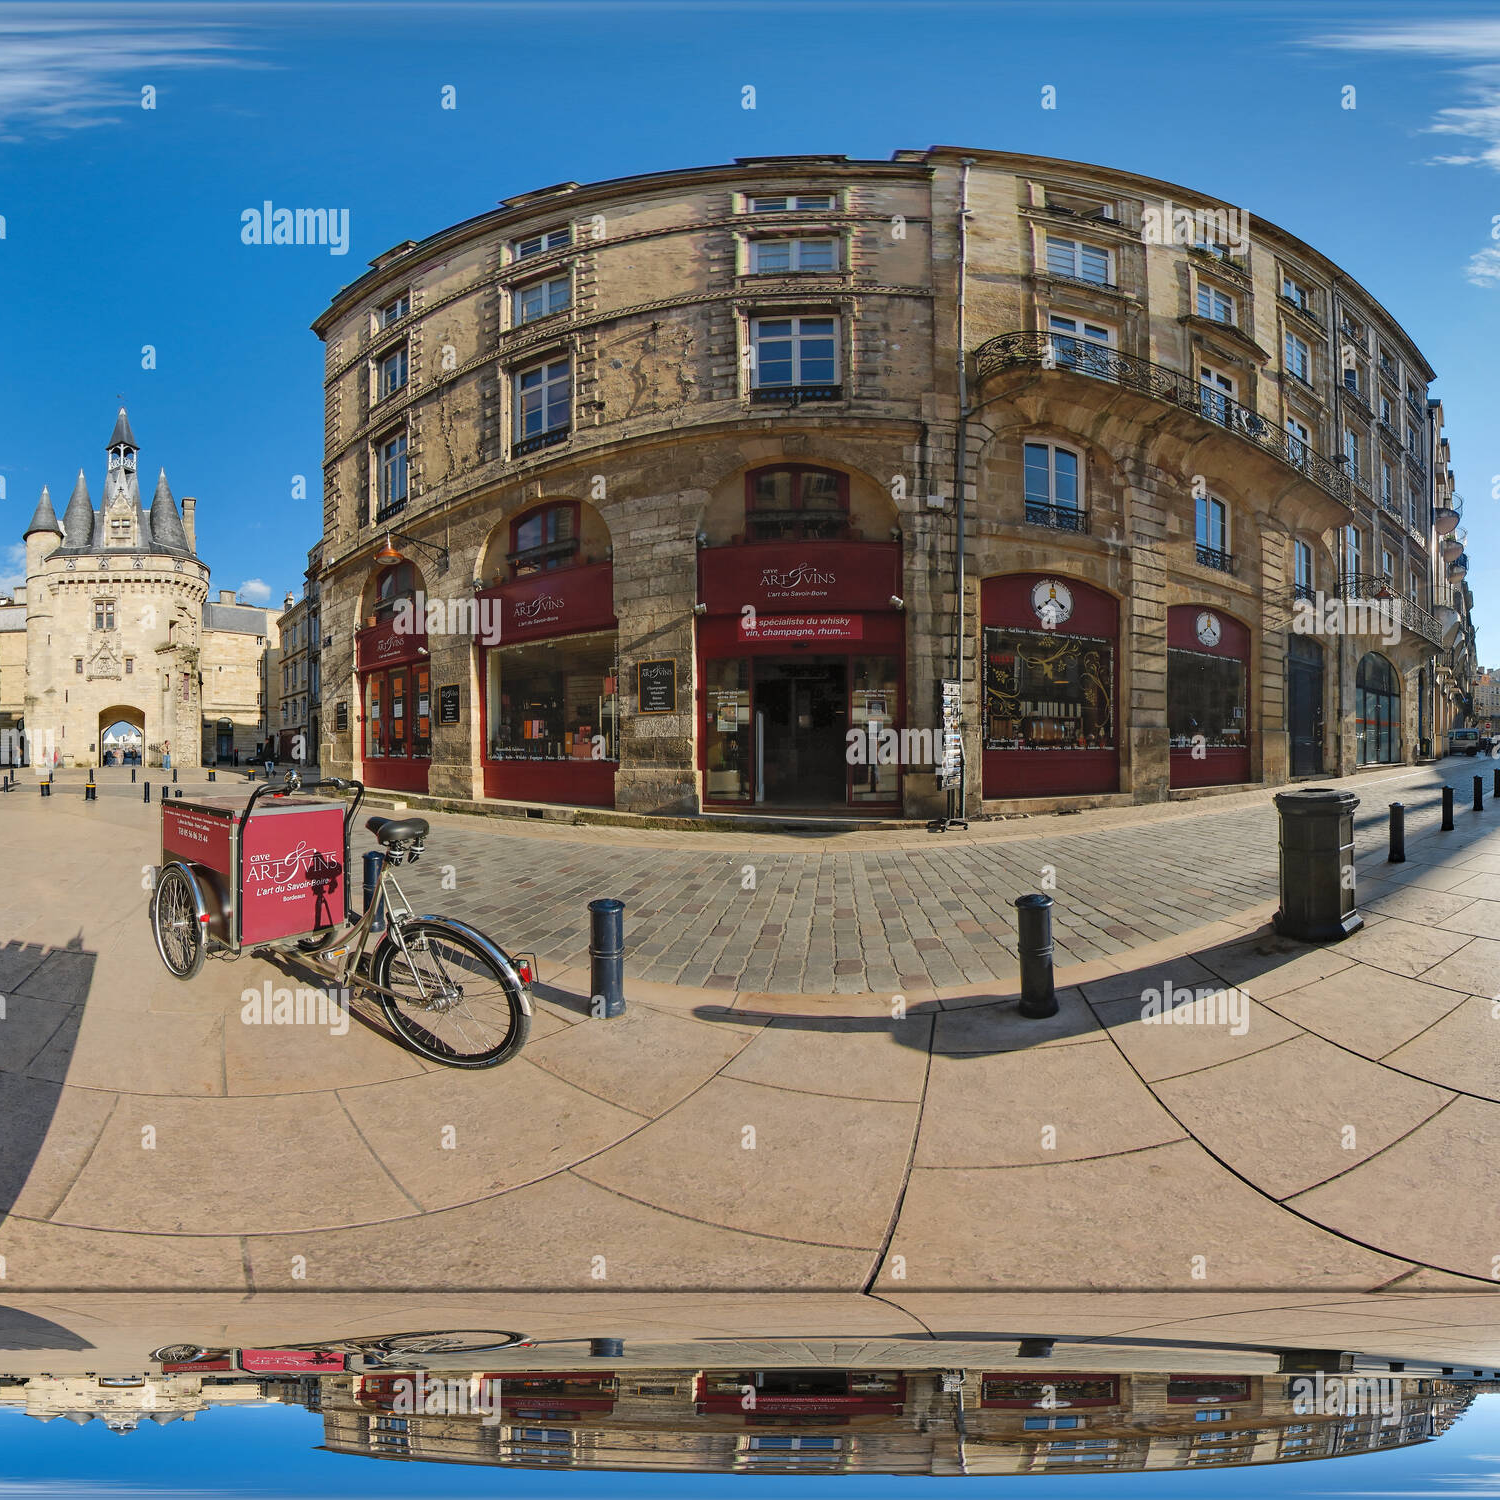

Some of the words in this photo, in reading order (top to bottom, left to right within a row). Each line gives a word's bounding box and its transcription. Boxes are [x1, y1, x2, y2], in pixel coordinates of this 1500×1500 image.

[760, 574, 788, 586] ART
[803, 573, 836, 584] VINS
[513, 605, 532, 616] ART
[541, 598, 565, 610] VINS
[759, 617, 805, 627] spécialiste
[806, 617, 818, 625] du
[820, 617, 851, 626] whisky
[745, 629, 760, 637] vin,
[762, 628, 815, 637] champagne,
[250, 853, 270, 862] cave
[246, 862, 284, 882] ART
[301, 853, 338, 873] VINS
[256, 886, 274, 897] L'art
[275, 885, 285, 893] du
[286, 877, 330, 892] Savoir-Boire
[283, 893, 306, 902] Bordeaux
